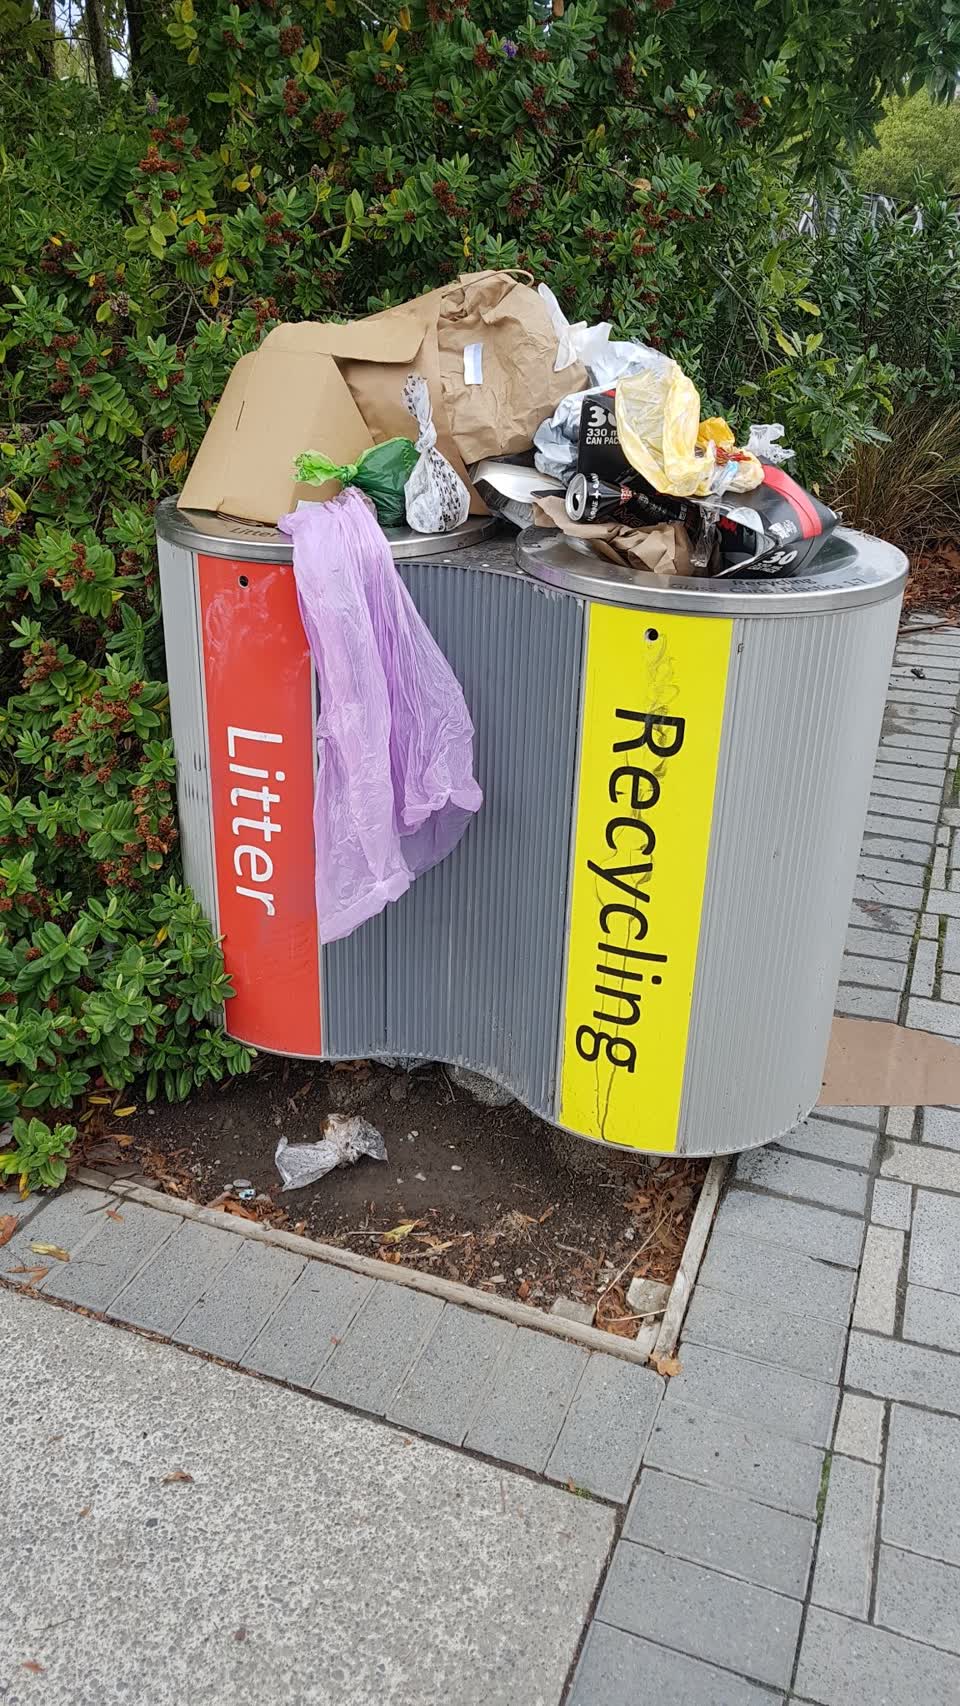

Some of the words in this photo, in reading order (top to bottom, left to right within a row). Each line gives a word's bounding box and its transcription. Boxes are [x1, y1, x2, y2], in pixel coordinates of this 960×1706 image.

[586, 428, 608, 437] 330
[585, 436, 602, 445] CAN
[603, 436, 621, 445] PAC
[229, 527, 281, 537] Litter
[762, 550, 799, 565] 30
[731, 578, 817, 587] Recycling
[779, 584, 843, 593] Plastics
[227, 726, 286, 916] Litter
[575, 708, 686, 1073] Recycling
